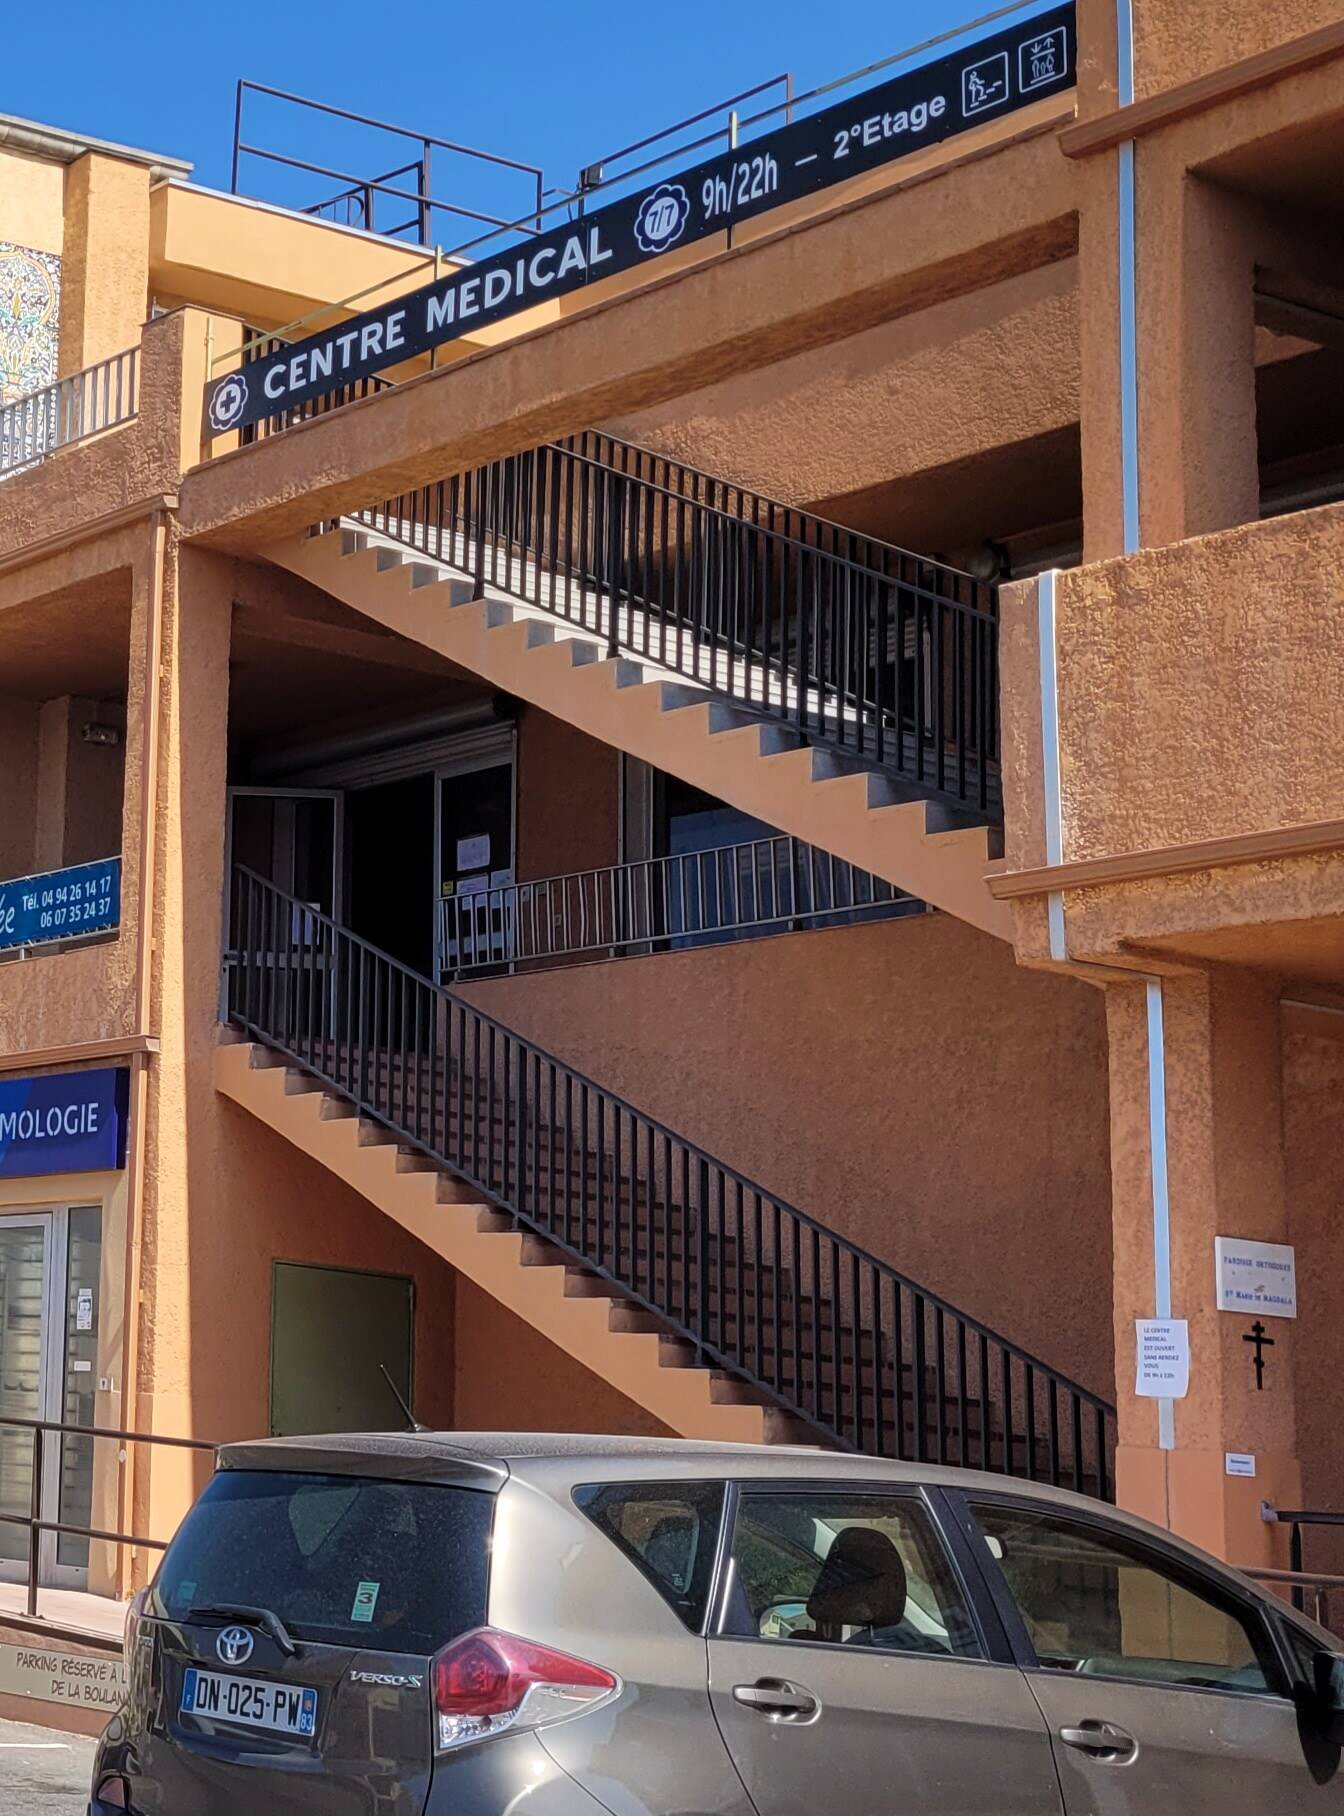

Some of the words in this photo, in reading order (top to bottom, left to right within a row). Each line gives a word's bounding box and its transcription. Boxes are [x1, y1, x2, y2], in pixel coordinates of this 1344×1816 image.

[264, 310, 406, 400] CENTRE
[426, 225, 613, 333] MEDICAL
[649, 203, 675, 234] 7/7
[702, 151, 777, 220] 9h/22h
[22, 894, 39, 912] Tél.
[42, 890, 53, 907] 04
[56, 887, 67, 904] 94
[70, 884, 81, 901] 26
[84, 880, 96, 897] 14
[100, 876, 111, 894] 17
[40, 911, 52, 928] 06
[54, 908, 66, 925] 07
[69, 905, 81, 922] 35
[83, 902, 95, 919] 24
[98, 898, 111, 916] 37
[358, 1592, 373, 1604] 3
[16, 1652, 58, 1672] PARKING
[62, 1658, 106, 1680] RÉSERVÉ
[349, 1669, 424, 1689] VERSO-S
[51, 1680, 65, 1695] DE
[68, 1683, 81, 1699] LA
[196, 1677, 300, 1727] DN-025-PW
[301, 1713, 313, 1731] 83
